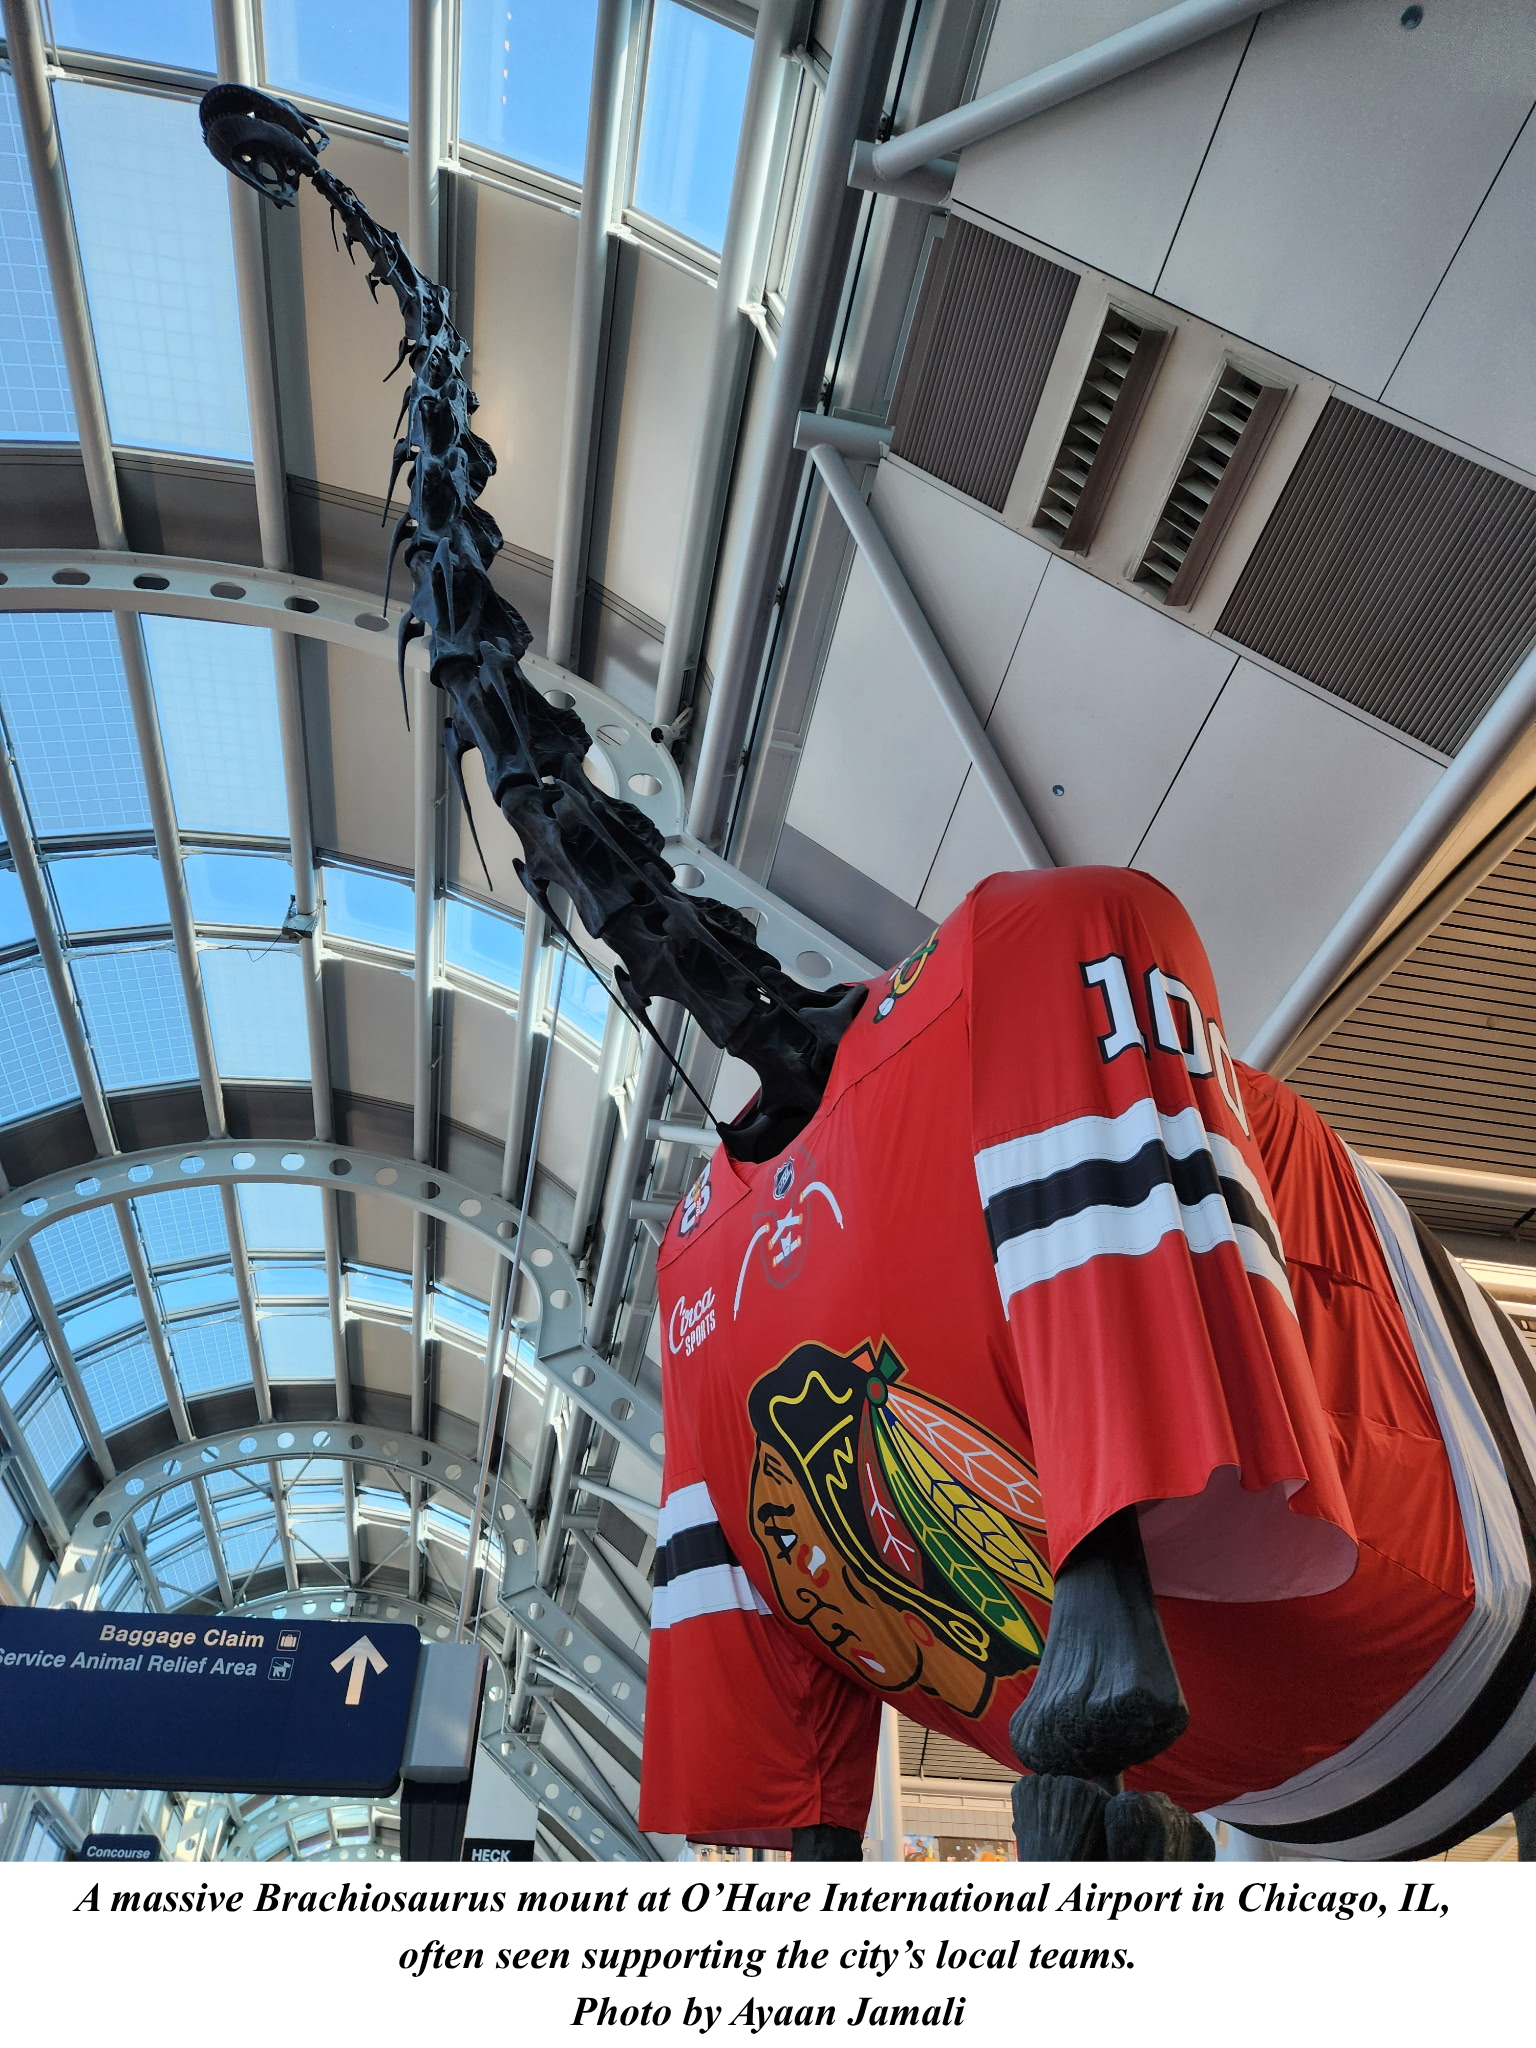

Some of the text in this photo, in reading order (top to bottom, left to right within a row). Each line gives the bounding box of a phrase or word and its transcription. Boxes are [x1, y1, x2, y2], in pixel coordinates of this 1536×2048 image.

[1079, 952, 1251, 1141] 100
[669, 1287, 715, 1354] Circa
[685, 1309, 716, 1357] SPORTS
[100, 1624, 265, 1648] Baggage Claim
[70, 1651, 143, 1671] Animal
[147, 1654, 208, 1674] Relief
[209, 1657, 258, 1676] Area
[86, 1845, 151, 1859] Concourse
[471, 1848, 511, 1862] HECK
